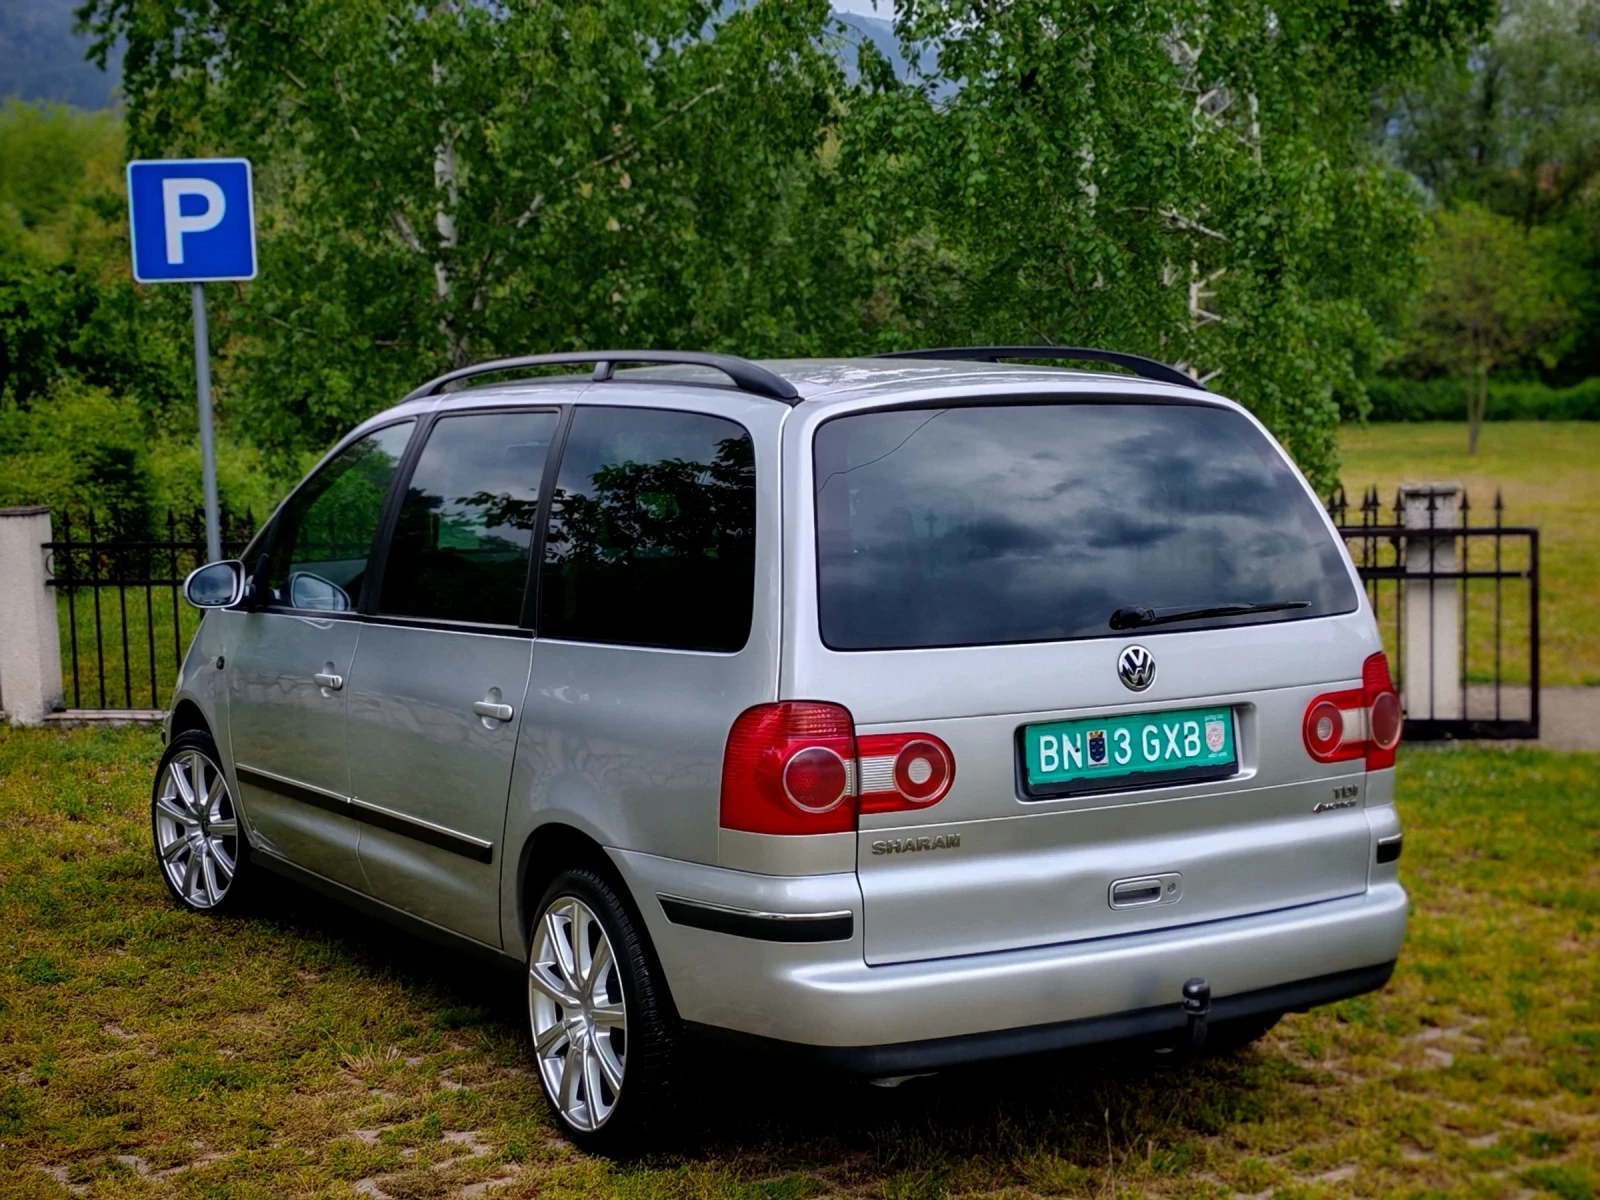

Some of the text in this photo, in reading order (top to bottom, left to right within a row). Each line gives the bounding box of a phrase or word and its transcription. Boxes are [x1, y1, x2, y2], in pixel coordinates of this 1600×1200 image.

[162, 178, 227, 265] P
[1039, 721, 1200, 773] BN 3 GXB
[871, 833, 961, 856] SHARAN
